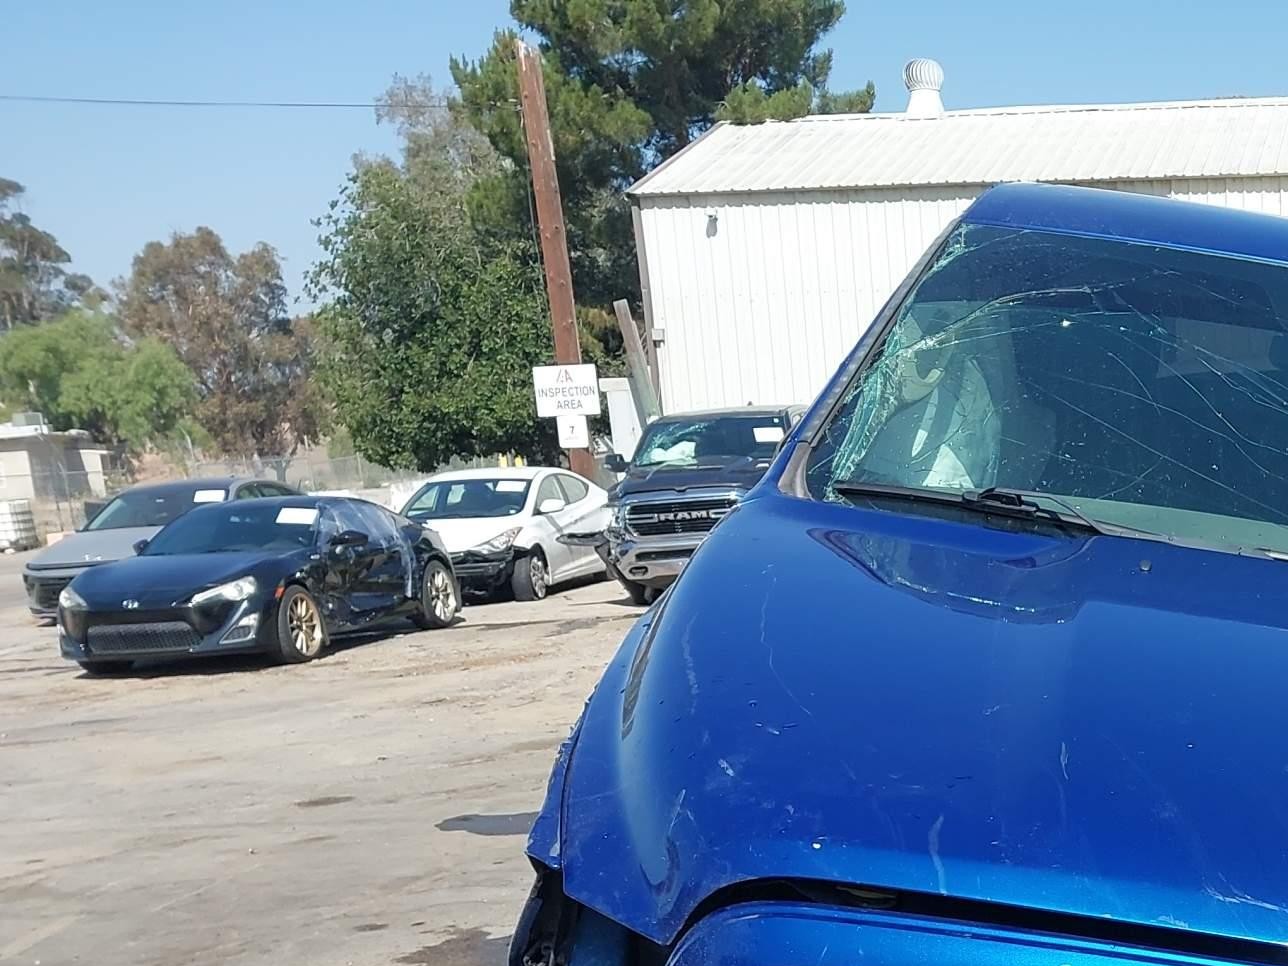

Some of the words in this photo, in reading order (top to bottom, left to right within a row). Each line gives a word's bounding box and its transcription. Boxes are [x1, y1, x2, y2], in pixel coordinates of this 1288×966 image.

[538, 385, 595, 398] INSPECTION
[556, 399, 583, 409] AREA
[660, 510, 708, 521] RAM
